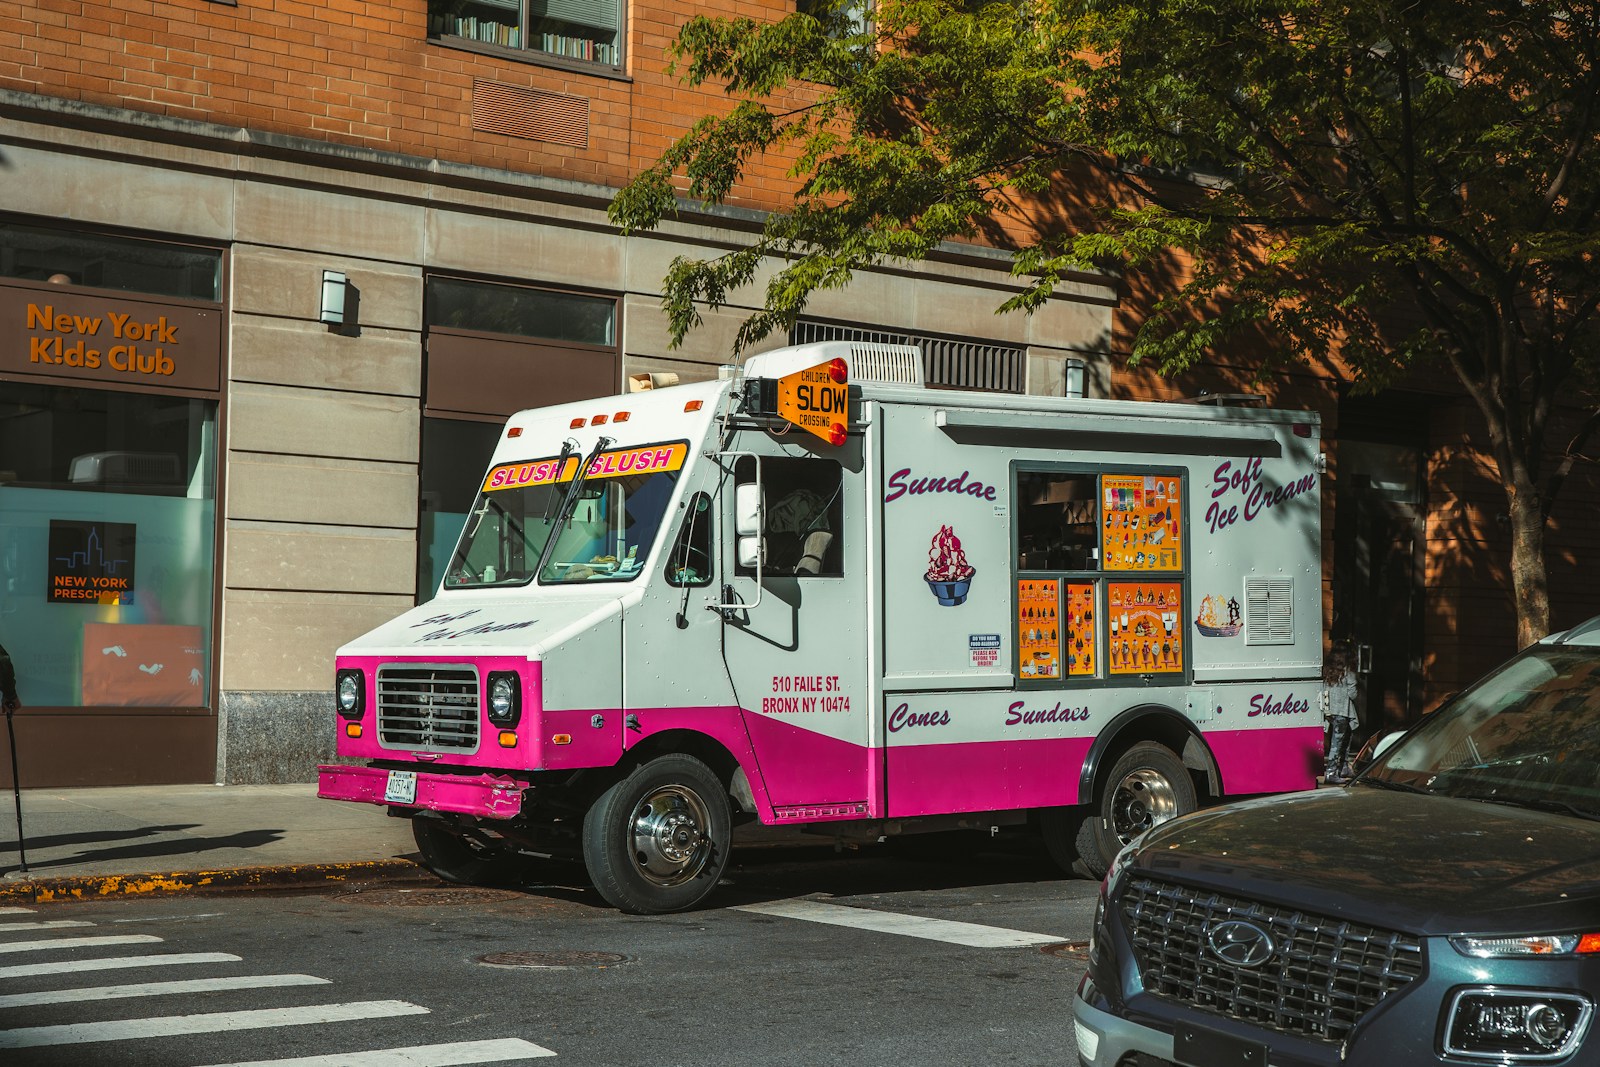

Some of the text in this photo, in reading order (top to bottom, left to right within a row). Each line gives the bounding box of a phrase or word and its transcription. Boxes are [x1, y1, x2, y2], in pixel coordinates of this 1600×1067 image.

[27, 304, 179, 344] New York
[30, 337, 175, 375] K!ds Club
[801, 371, 831, 384] CHILDREN
[797, 385, 846, 414] SLOW
[799, 414, 830, 428] CROSSING
[490, 460, 568, 488] SLUSH
[588, 448, 674, 476] SLUSH
[884, 467, 997, 503] Sundae
[1211, 455, 1263, 499] Soft
[1205, 473, 1317, 534] Ice Cream
[54, 575, 128, 588] NEW YORK
[54, 588, 128, 600] PRESCHOOL
[772, 676, 840, 692] 510 FAILE ST.
[762, 696, 850, 713] BRONX NY 10474
[888, 702, 951, 733] Cones
[1005, 701, 1091, 726] Sundaes
[1247, 692, 1310, 717] Shakes
